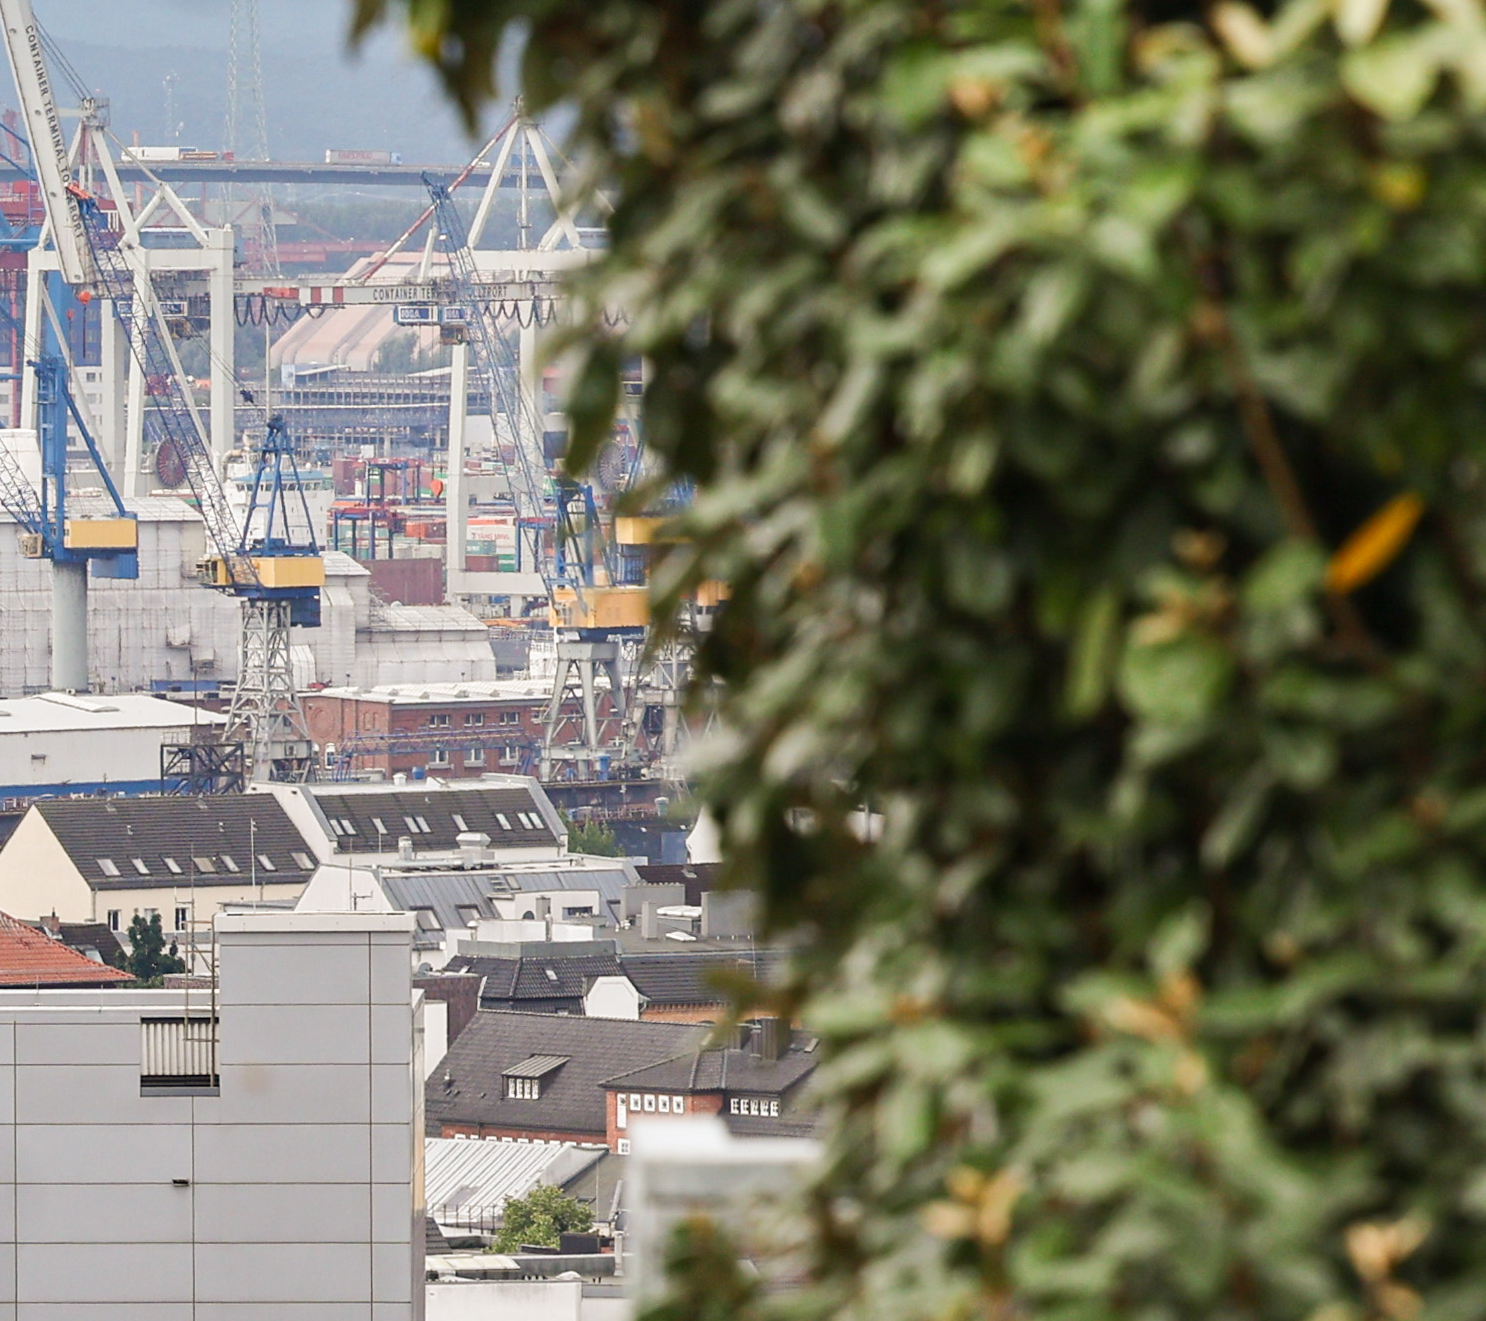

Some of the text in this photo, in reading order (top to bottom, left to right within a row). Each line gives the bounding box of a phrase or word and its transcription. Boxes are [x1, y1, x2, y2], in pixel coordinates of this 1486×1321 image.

[25, 25, 49, 96] CONTAINER
[43, 100, 63, 164] TERMINAL
[372, 288, 418, 299] CONTAINER
